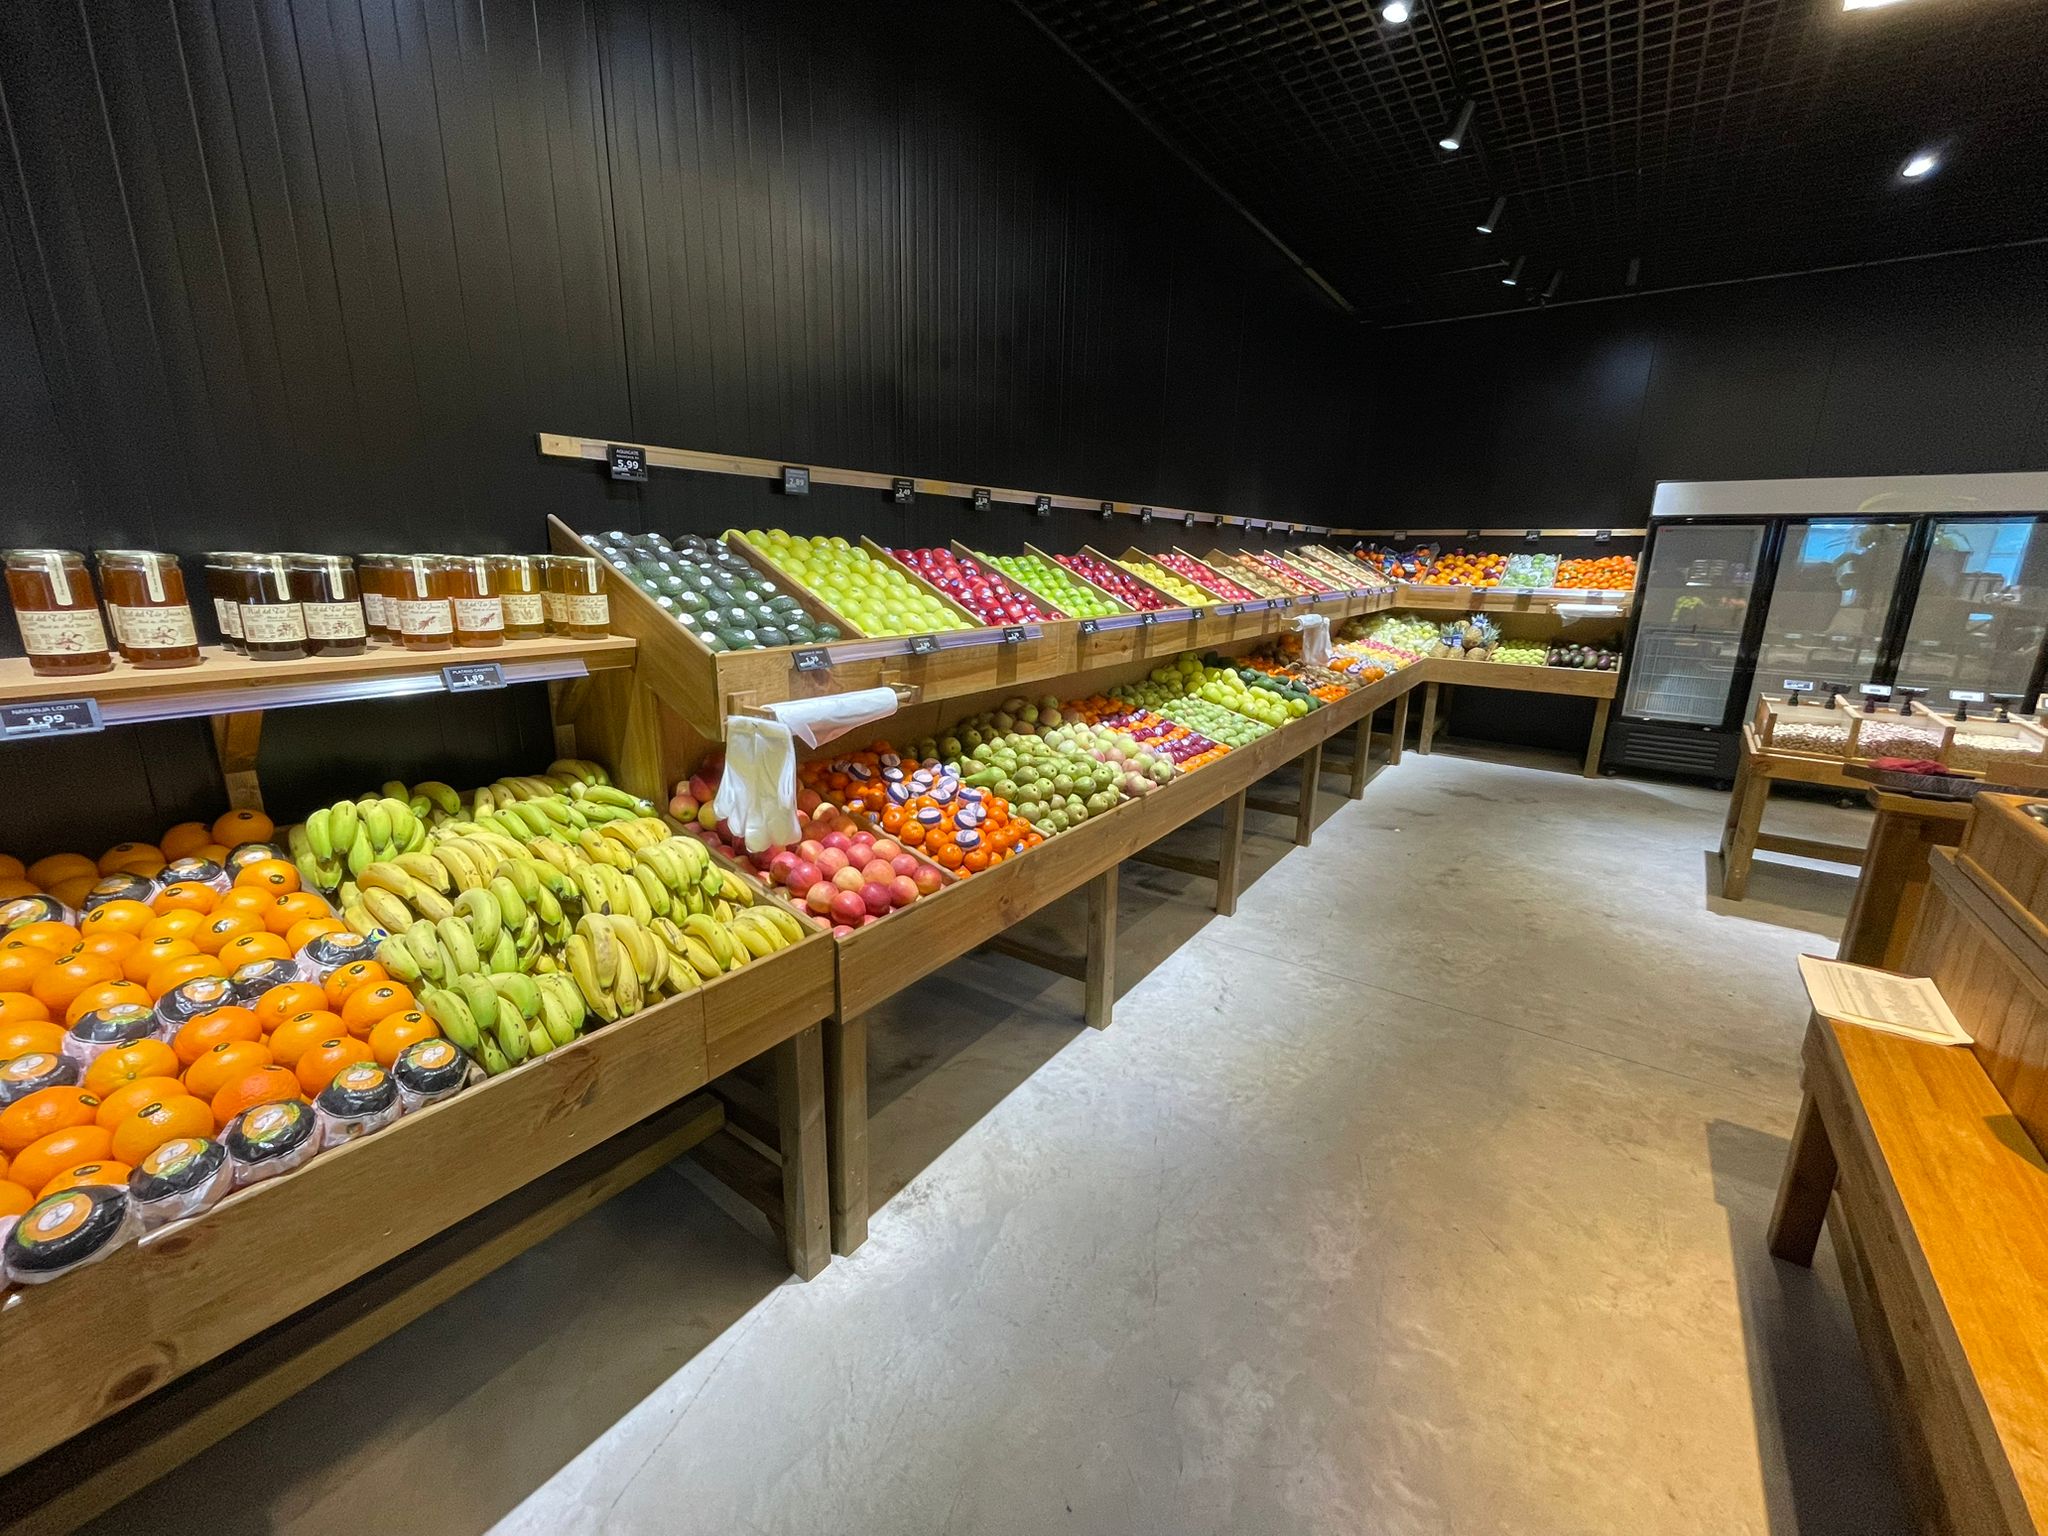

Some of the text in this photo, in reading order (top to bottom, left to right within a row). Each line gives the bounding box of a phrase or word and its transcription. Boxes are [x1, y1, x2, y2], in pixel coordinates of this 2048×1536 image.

[617, 459, 639, 470] 5.99
[11, 704, 81, 715] NARANJA LOLITA
[26, 714, 65, 726] 1.99
